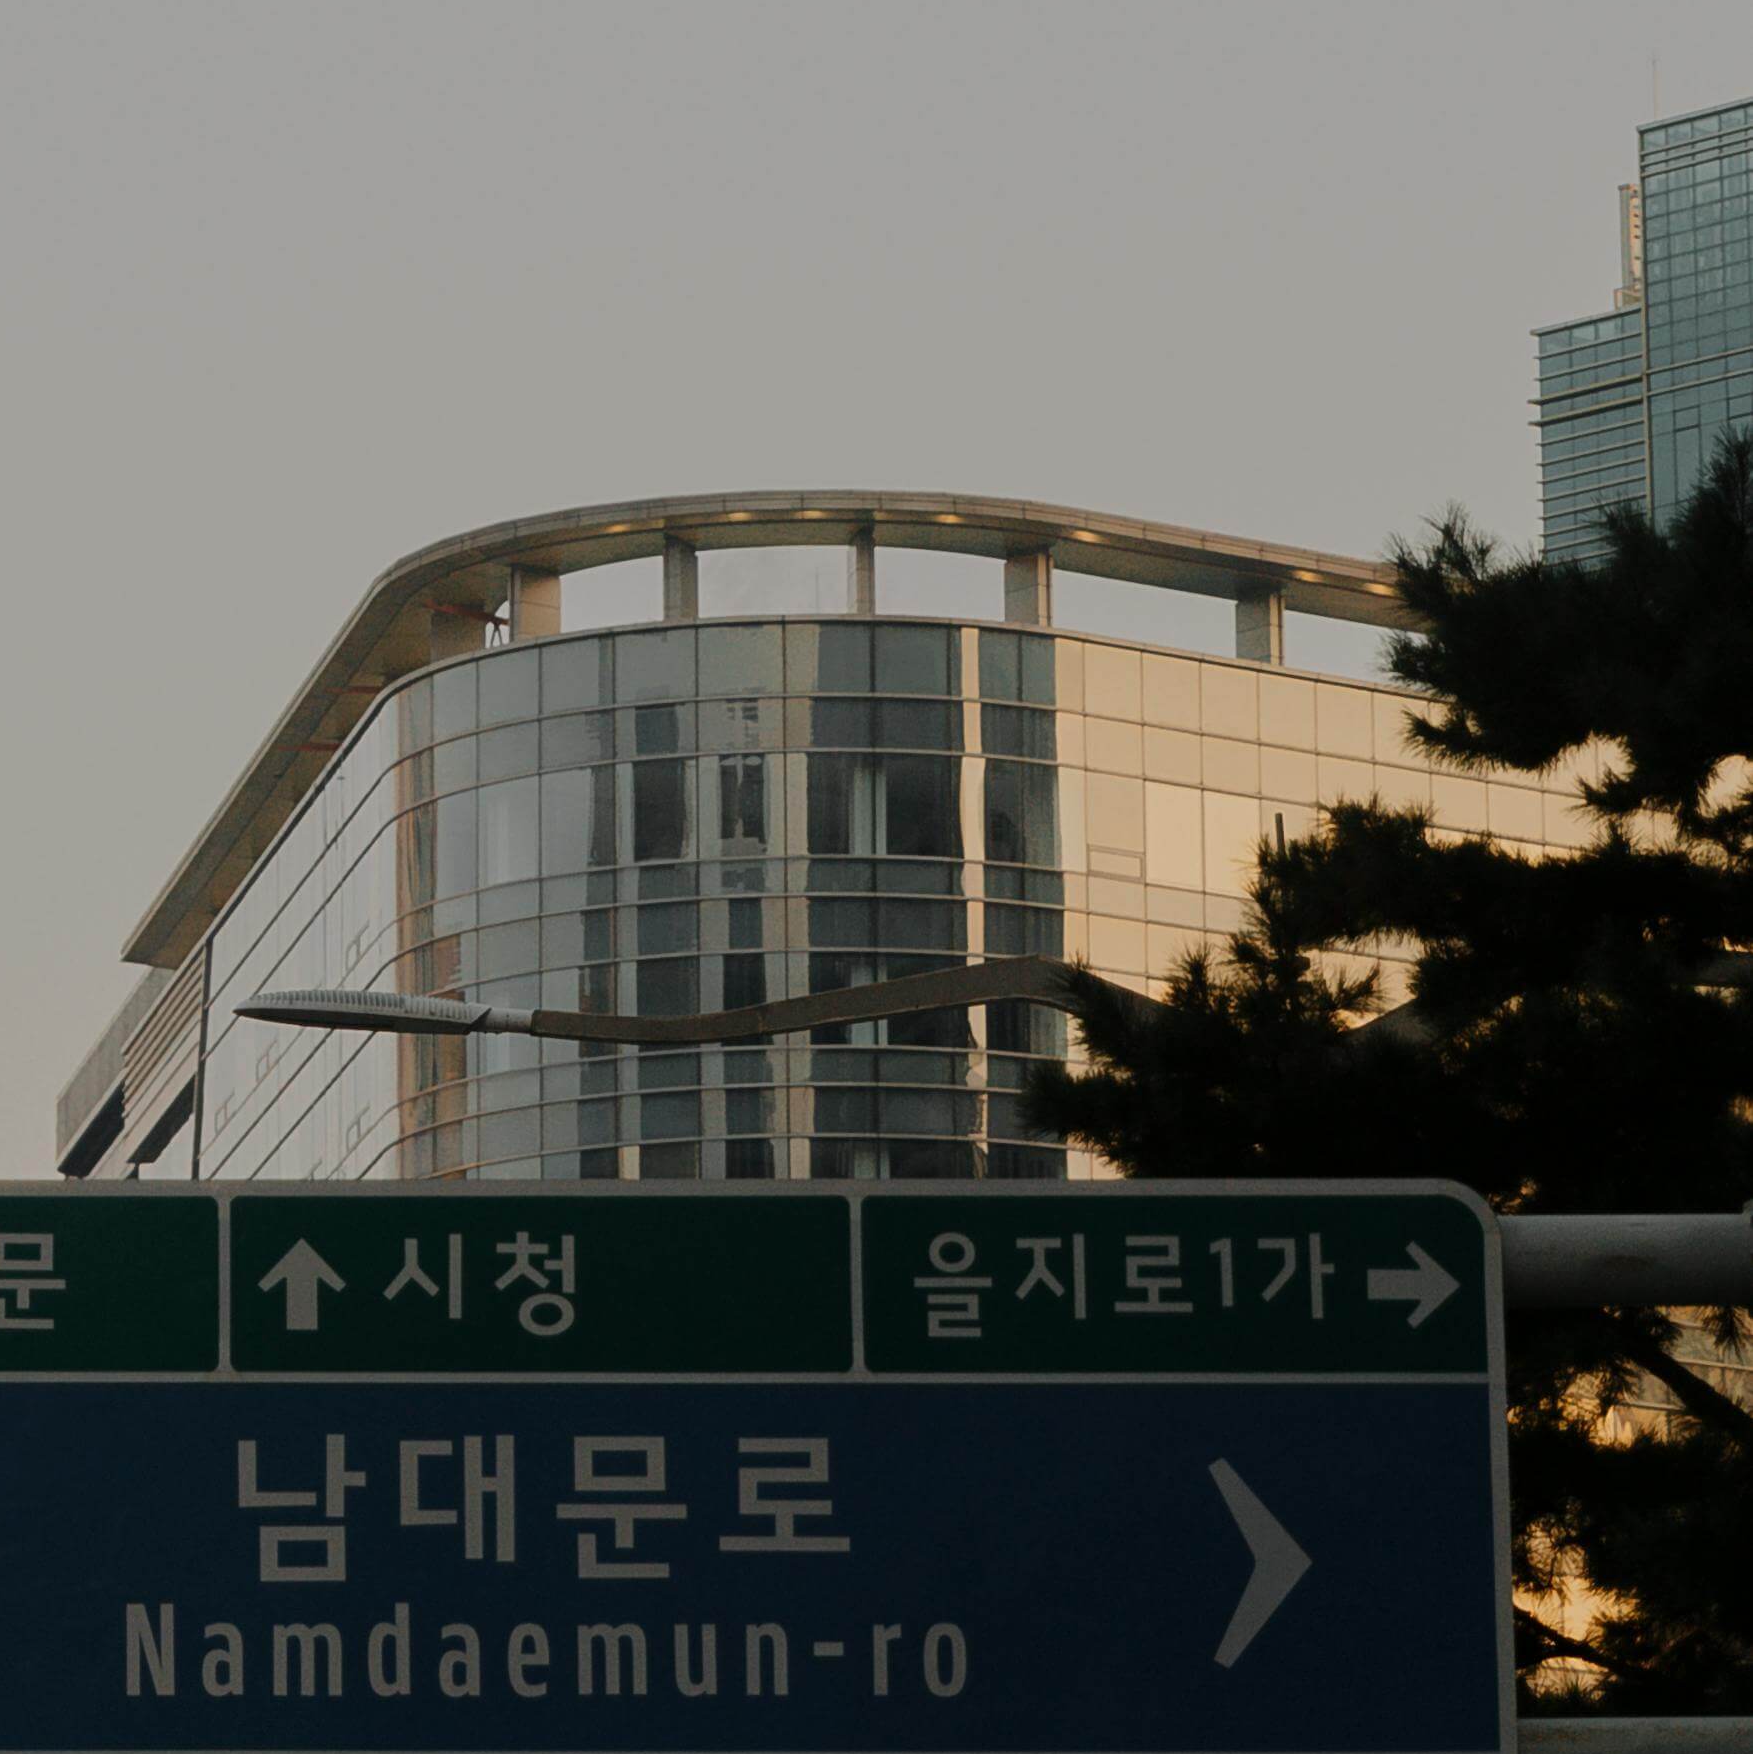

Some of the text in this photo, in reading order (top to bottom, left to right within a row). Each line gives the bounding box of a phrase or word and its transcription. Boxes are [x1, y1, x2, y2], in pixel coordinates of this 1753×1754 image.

[382, 1230, 580, 1337] 시청
[913, 1231, 1336, 1338] 을지로1가
[236, 1432, 851, 1584] 남대문로
[125, 1601, 968, 1699] Namdaemun-ro
